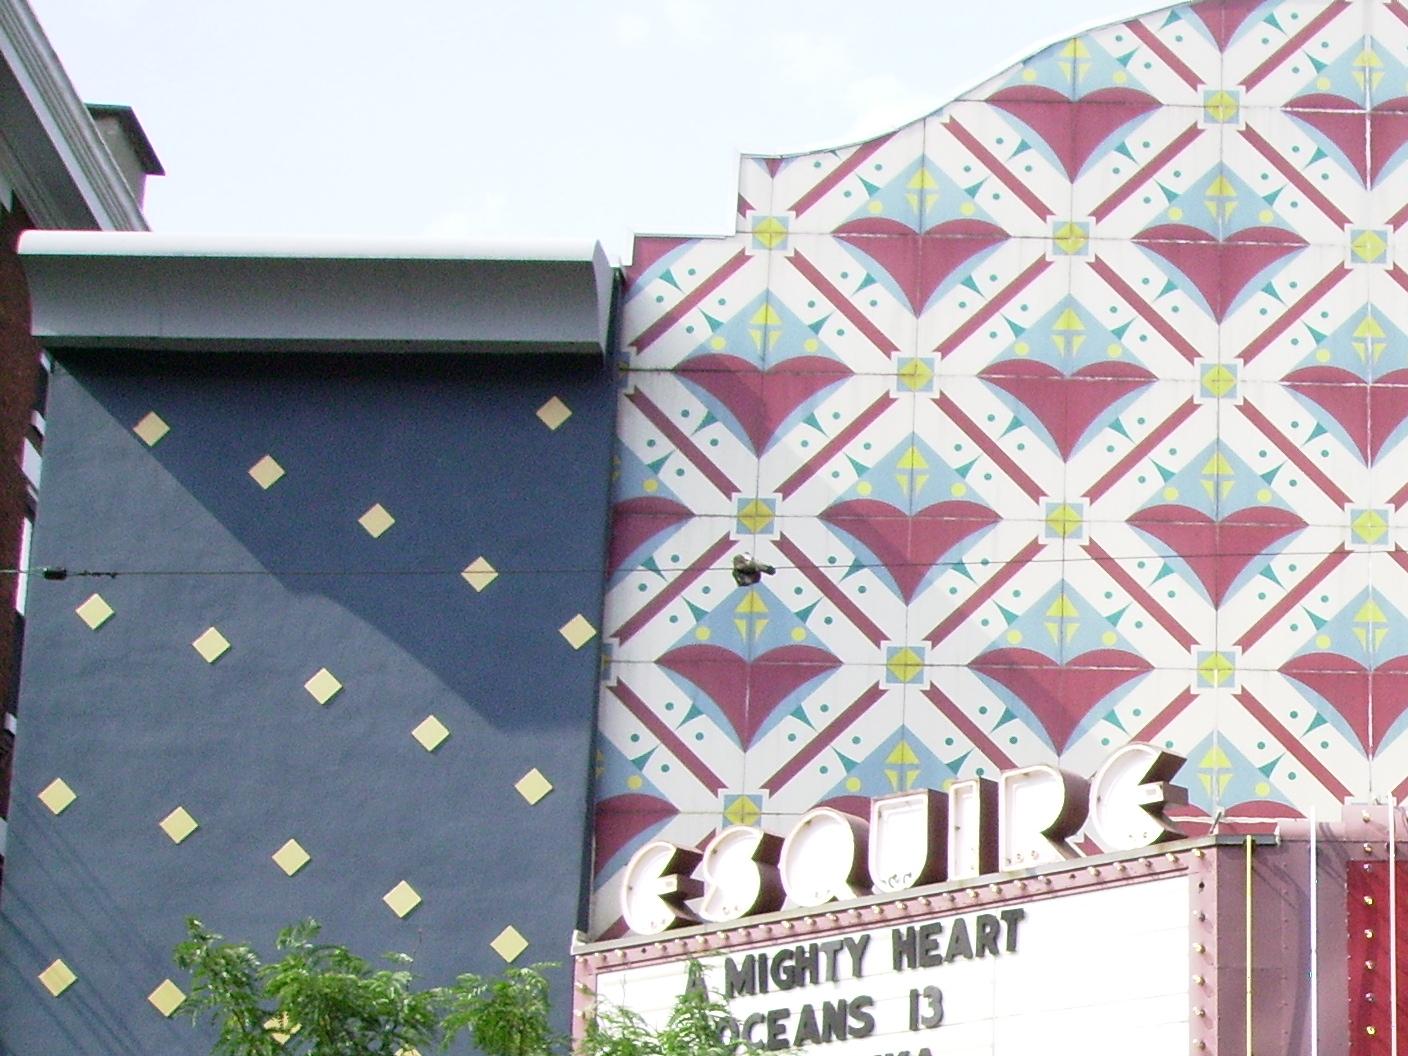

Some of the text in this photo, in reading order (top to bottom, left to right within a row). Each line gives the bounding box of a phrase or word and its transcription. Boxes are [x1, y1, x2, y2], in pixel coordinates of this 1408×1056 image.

[623, 742, 1188, 936] ESQUIRE
[685, 908, 1025, 1002] A MIGHTY HEART
[715, 986, 944, 1053] OCEANS 13
